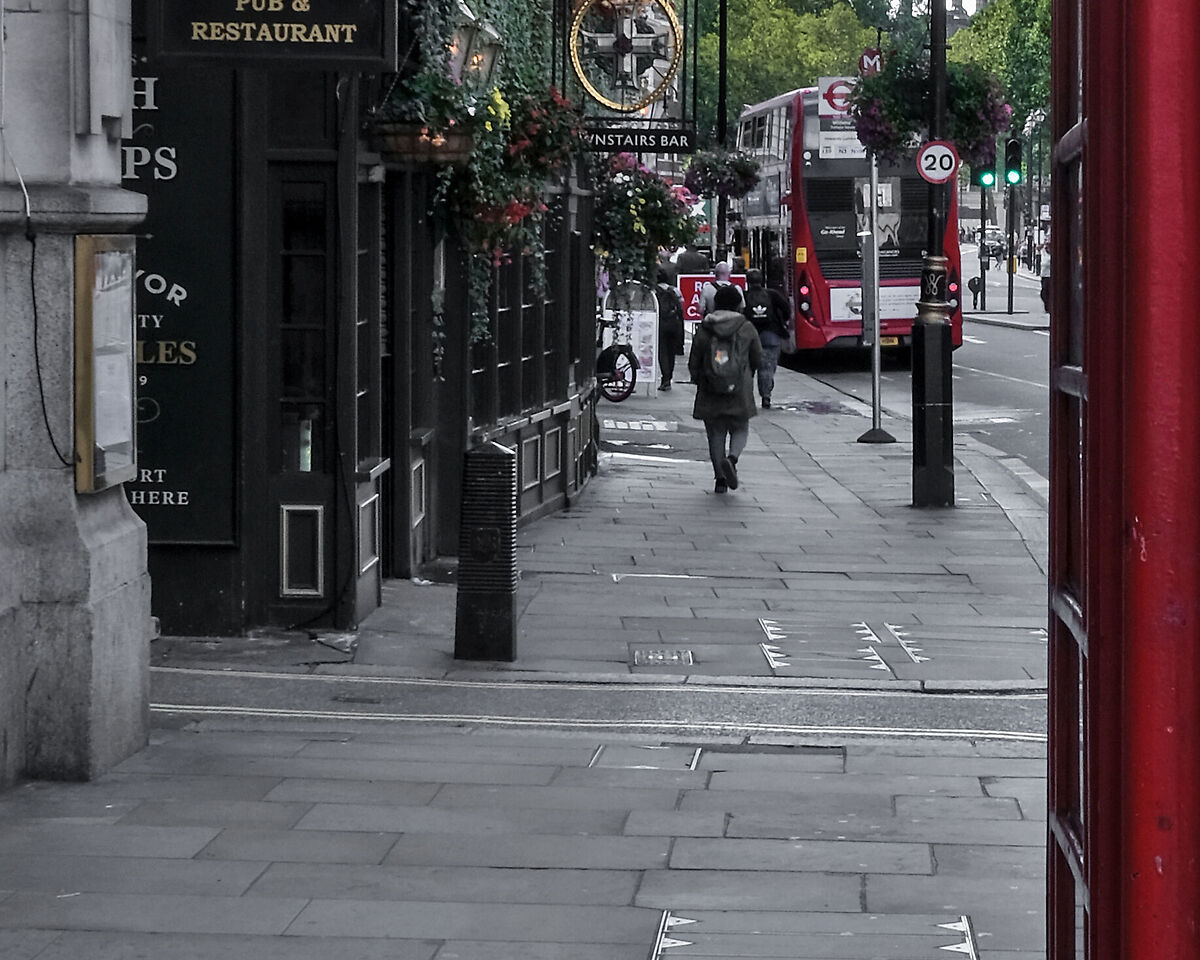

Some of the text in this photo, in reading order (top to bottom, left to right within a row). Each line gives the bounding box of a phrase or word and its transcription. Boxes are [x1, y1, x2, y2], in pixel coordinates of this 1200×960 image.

[191, 22, 358, 43] RESTAURANT
[863, 54, 881, 72] M
[660, 135, 689, 147] BAR
[122, 146, 178, 180] PS
[924, 154, 954, 172] 20
[136, 270, 188, 307] OR
[138, 314, 164, 328] TY
[130, 468, 167, 483] RT
[131, 490, 190, 505] HERE
